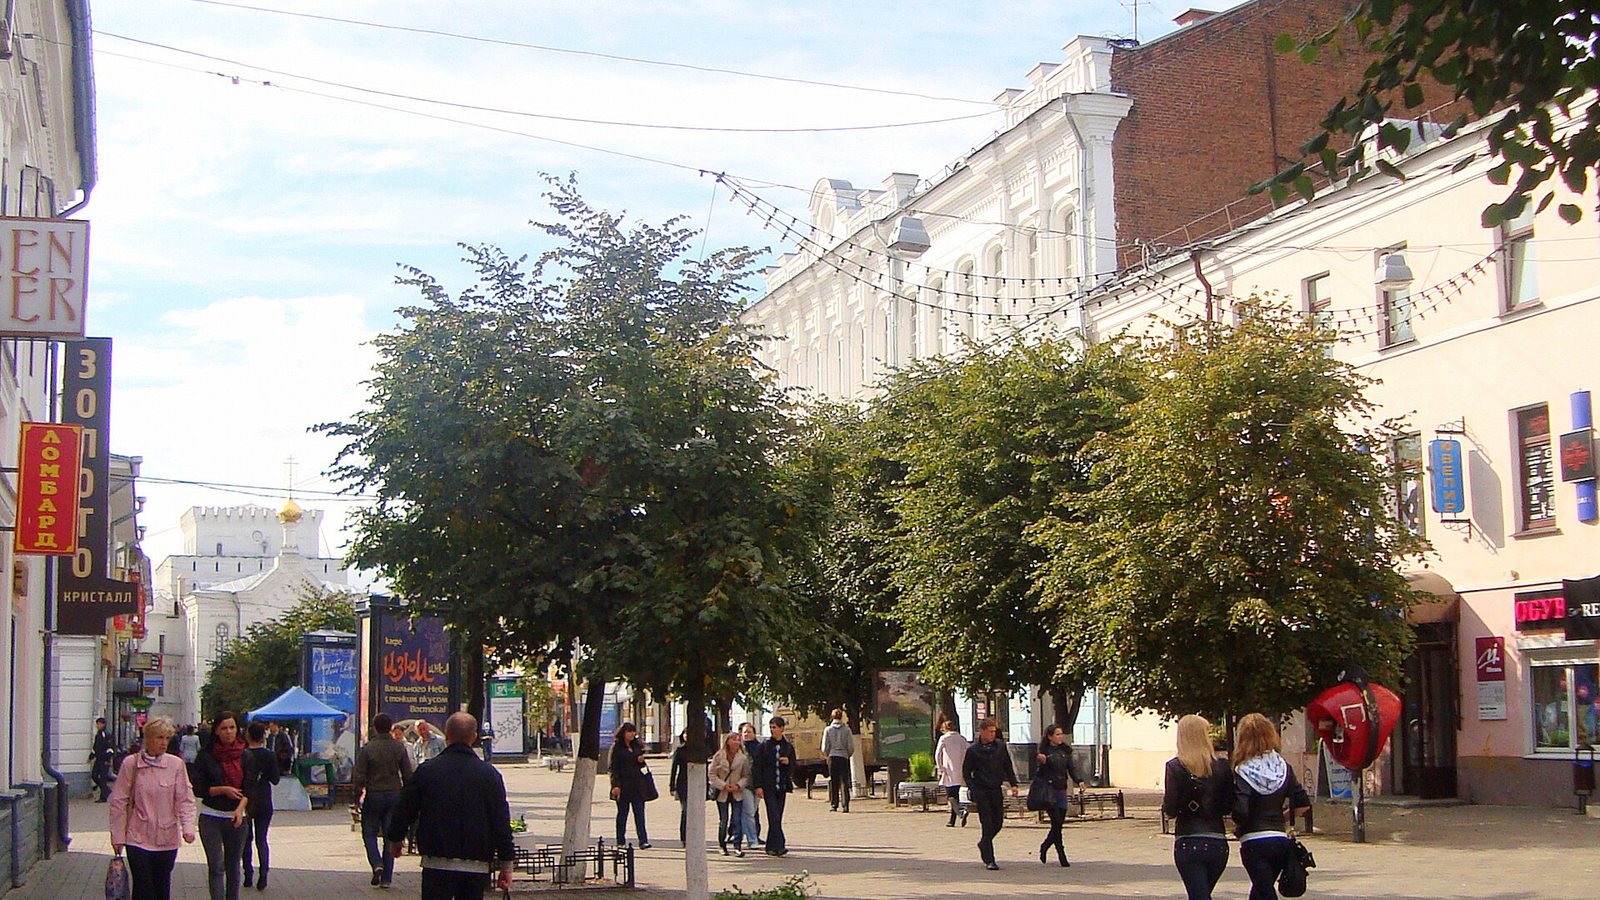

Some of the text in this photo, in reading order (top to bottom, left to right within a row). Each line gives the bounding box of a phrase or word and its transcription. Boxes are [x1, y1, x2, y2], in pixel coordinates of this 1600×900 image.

[0, 229, 76, 275] EN
[0, 275, 77, 322] ER
[71, 349, 98, 578] ЗОЛОТО
[34, 429, 62, 548] ЛОМБАРД
[63, 591, 132, 603] КРИСТАЛЛ
